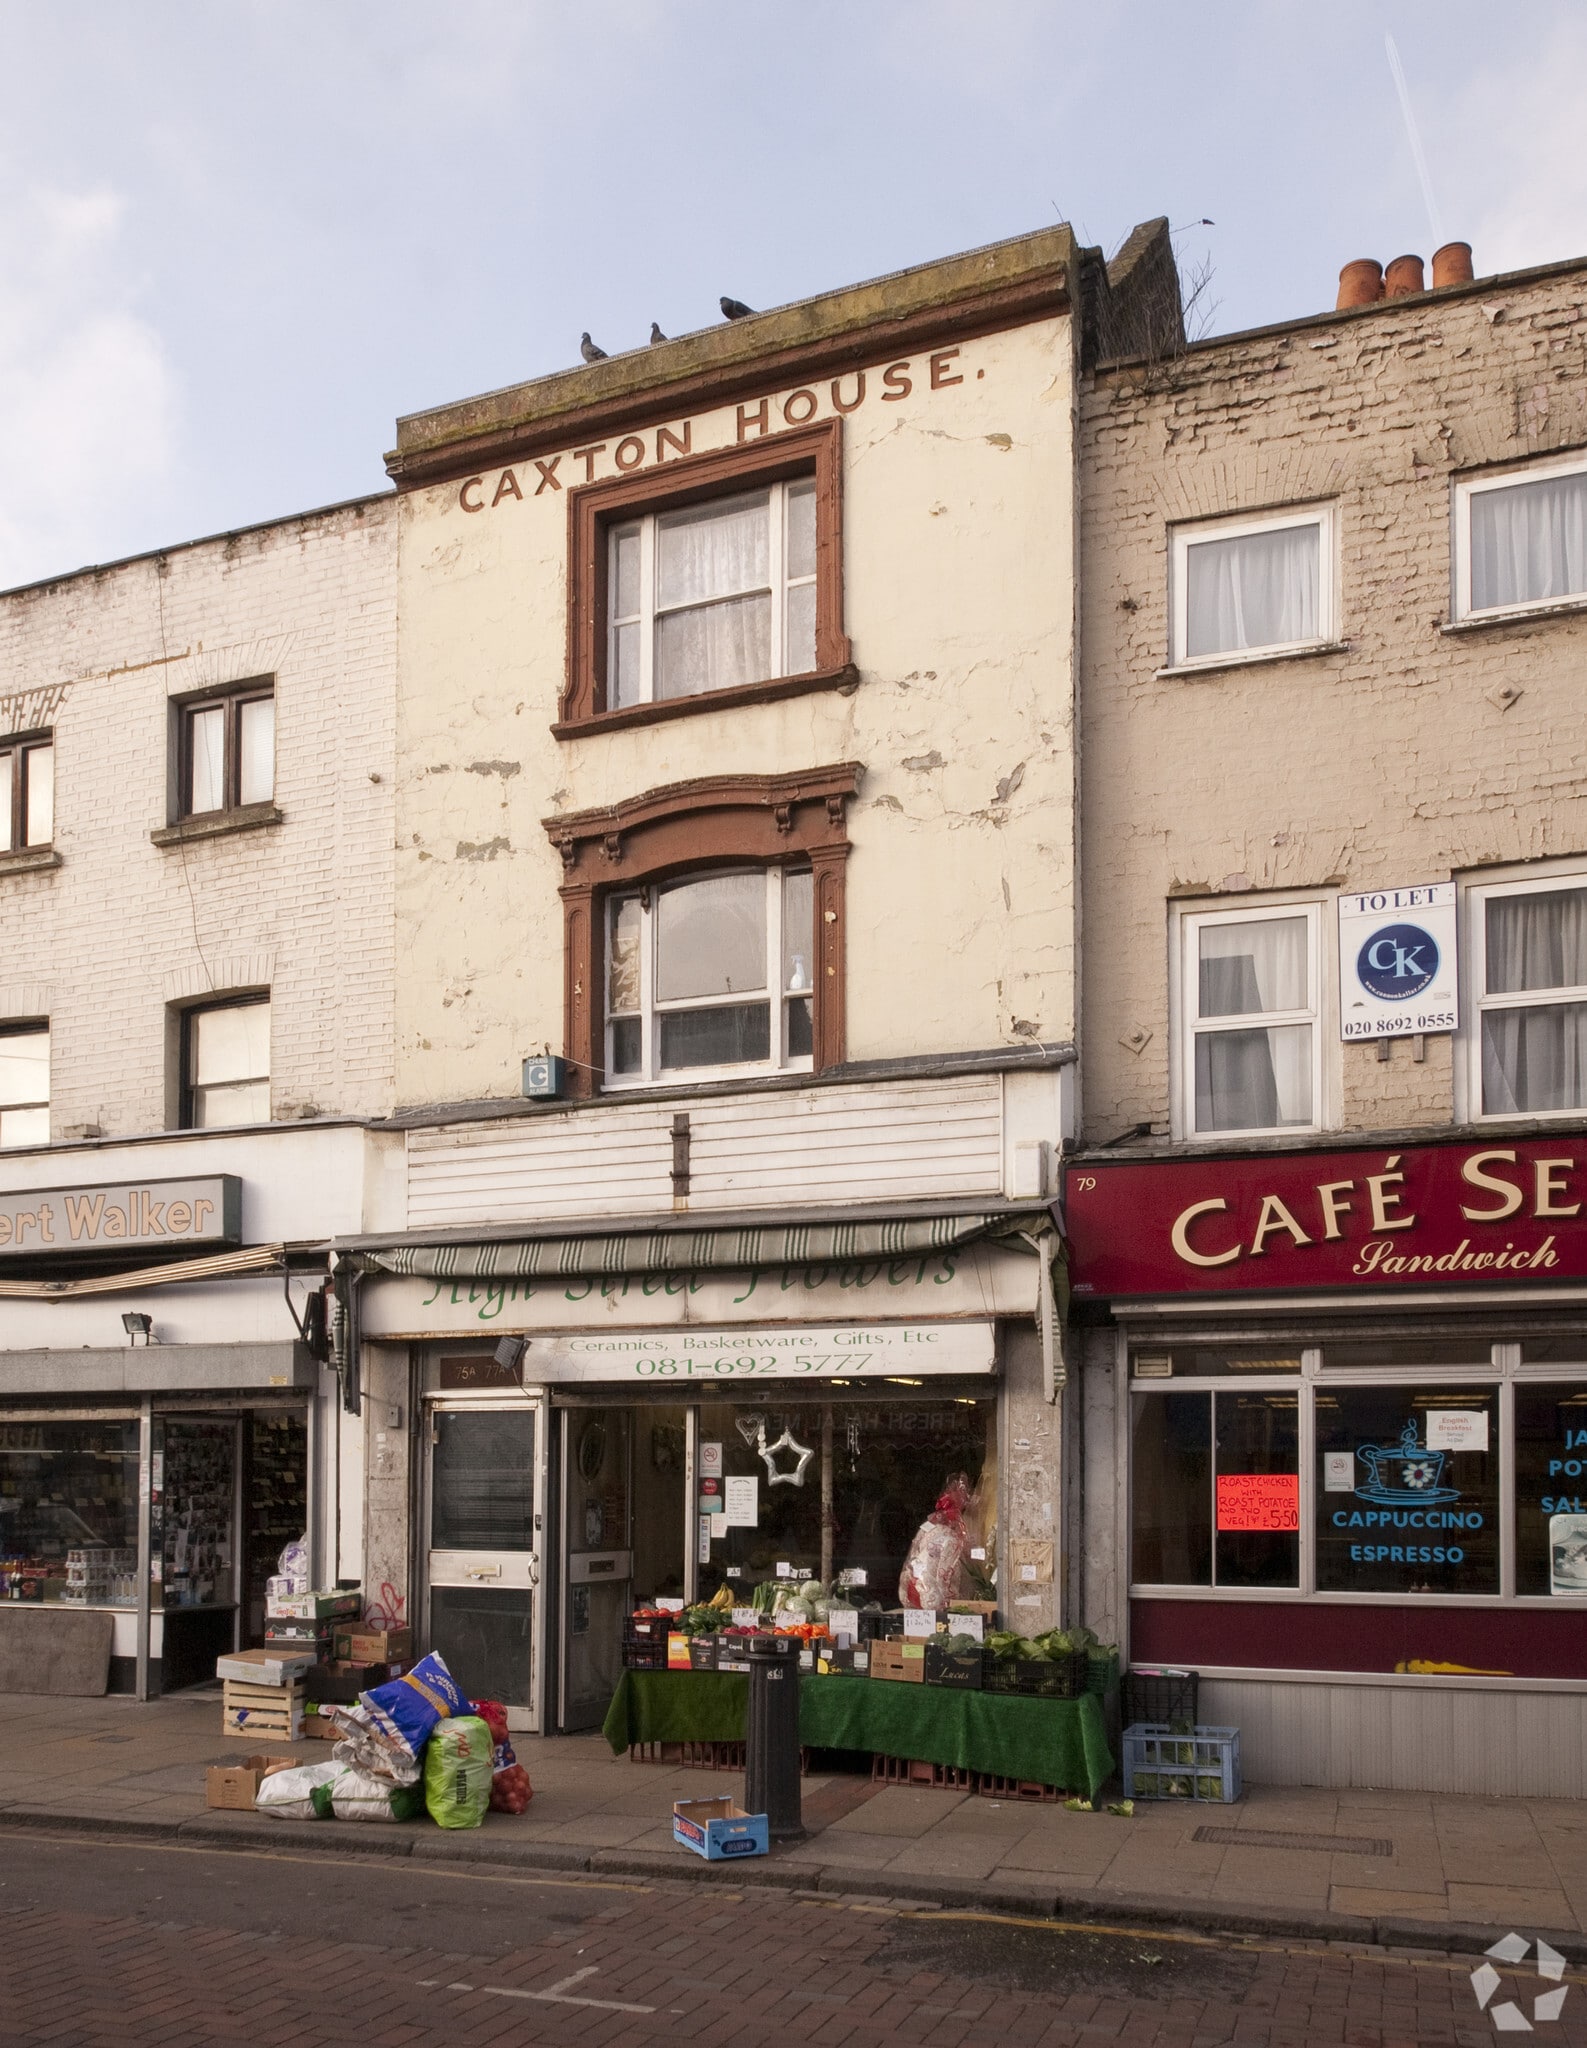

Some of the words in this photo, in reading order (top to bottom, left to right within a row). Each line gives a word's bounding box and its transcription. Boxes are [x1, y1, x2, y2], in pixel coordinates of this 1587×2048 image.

[459, 421, 692, 513] CAXTON
[737, 349, 986, 442] HOUSE.
[1355, 894, 1387, 912] TO
[1394, 888, 1438, 908] LET
[1368, 938, 1428, 978] CK
[1345, 1021, 1372, 1036] 020
[1376, 1017, 1412, 1033] 8692
[1418, 1012, 1455, 1028] 0555
[1077, 1177, 1097, 1191] 79
[64, 1190, 215, 1241] Walker
[1171, 1154, 1416, 1267] CAFÉ
[1352, 1235, 1560, 1275] Sandwich
[570, 1338, 669, 1352] Ceramics,
[682, 1333, 819, 1350] Basketware,
[833, 1331, 892, 1347] Gifts,
[903, 1330, 940, 1344] Etc
[792, 1352, 873, 1373] 5777
[1218, 1476, 1256, 1488] ROAST
[1256, 1476, 1293, 1488] CHICKEN
[1218, 1496, 1255, 1507] ROAST
[1240, 1507, 1261, 1515] TWO
[1332, 1510, 1484, 1529] CAPPUCCINO
[1350, 1545, 1464, 1563] ESPRESSO
